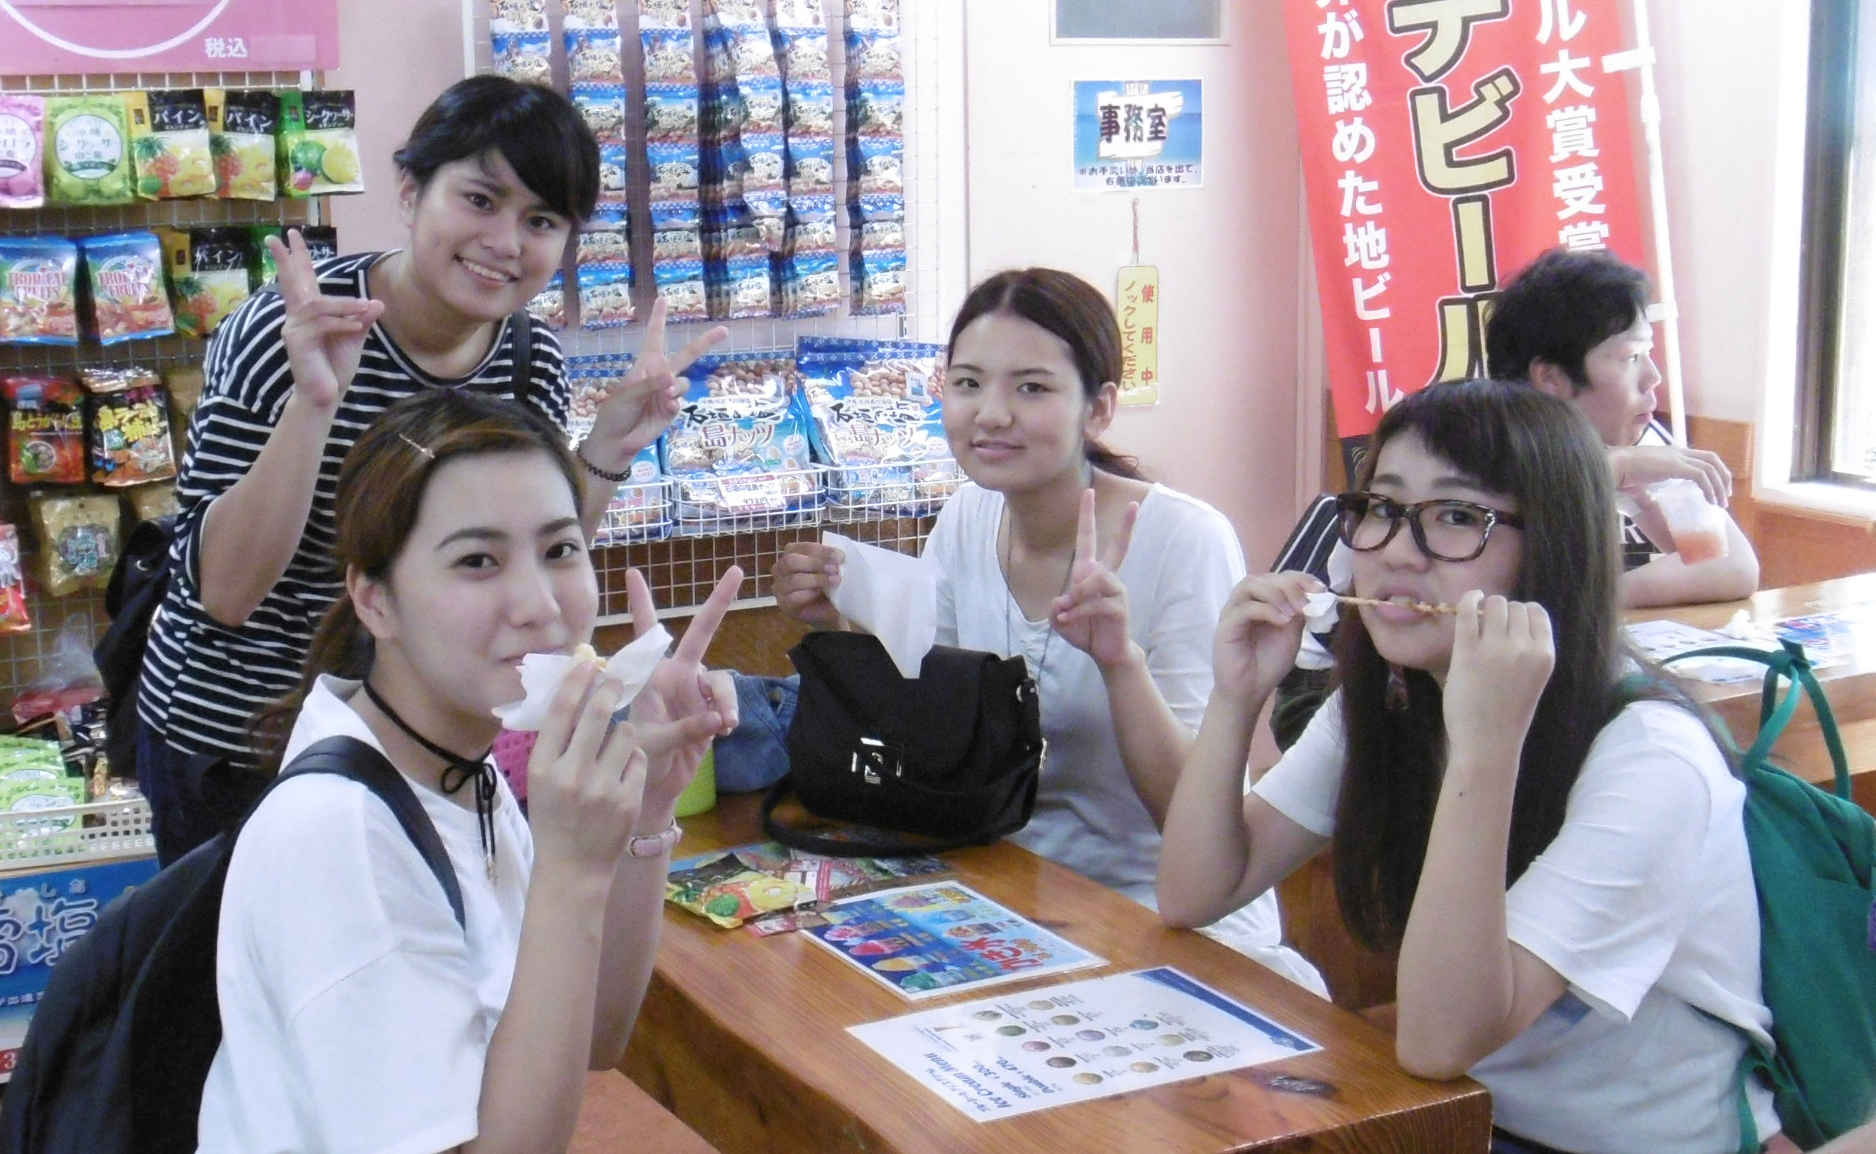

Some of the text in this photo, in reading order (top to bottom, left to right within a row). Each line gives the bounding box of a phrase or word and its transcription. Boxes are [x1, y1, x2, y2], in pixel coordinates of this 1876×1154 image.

[204, 37, 248, 58] 税込
[154, 110, 201, 124] パイン
[226, 112, 273, 128] パイン
[1100, 104, 1167, 143] 事務室
[1316, 0, 1404, 414] が認めた地ビール
[1122, 280, 1138, 392] ノックしてください
[1141, 283, 1155, 386] 使用中
[702, 423, 775, 449] 島ナッツ
[923, 1052, 1013, 1109] Ice Cream Menu
